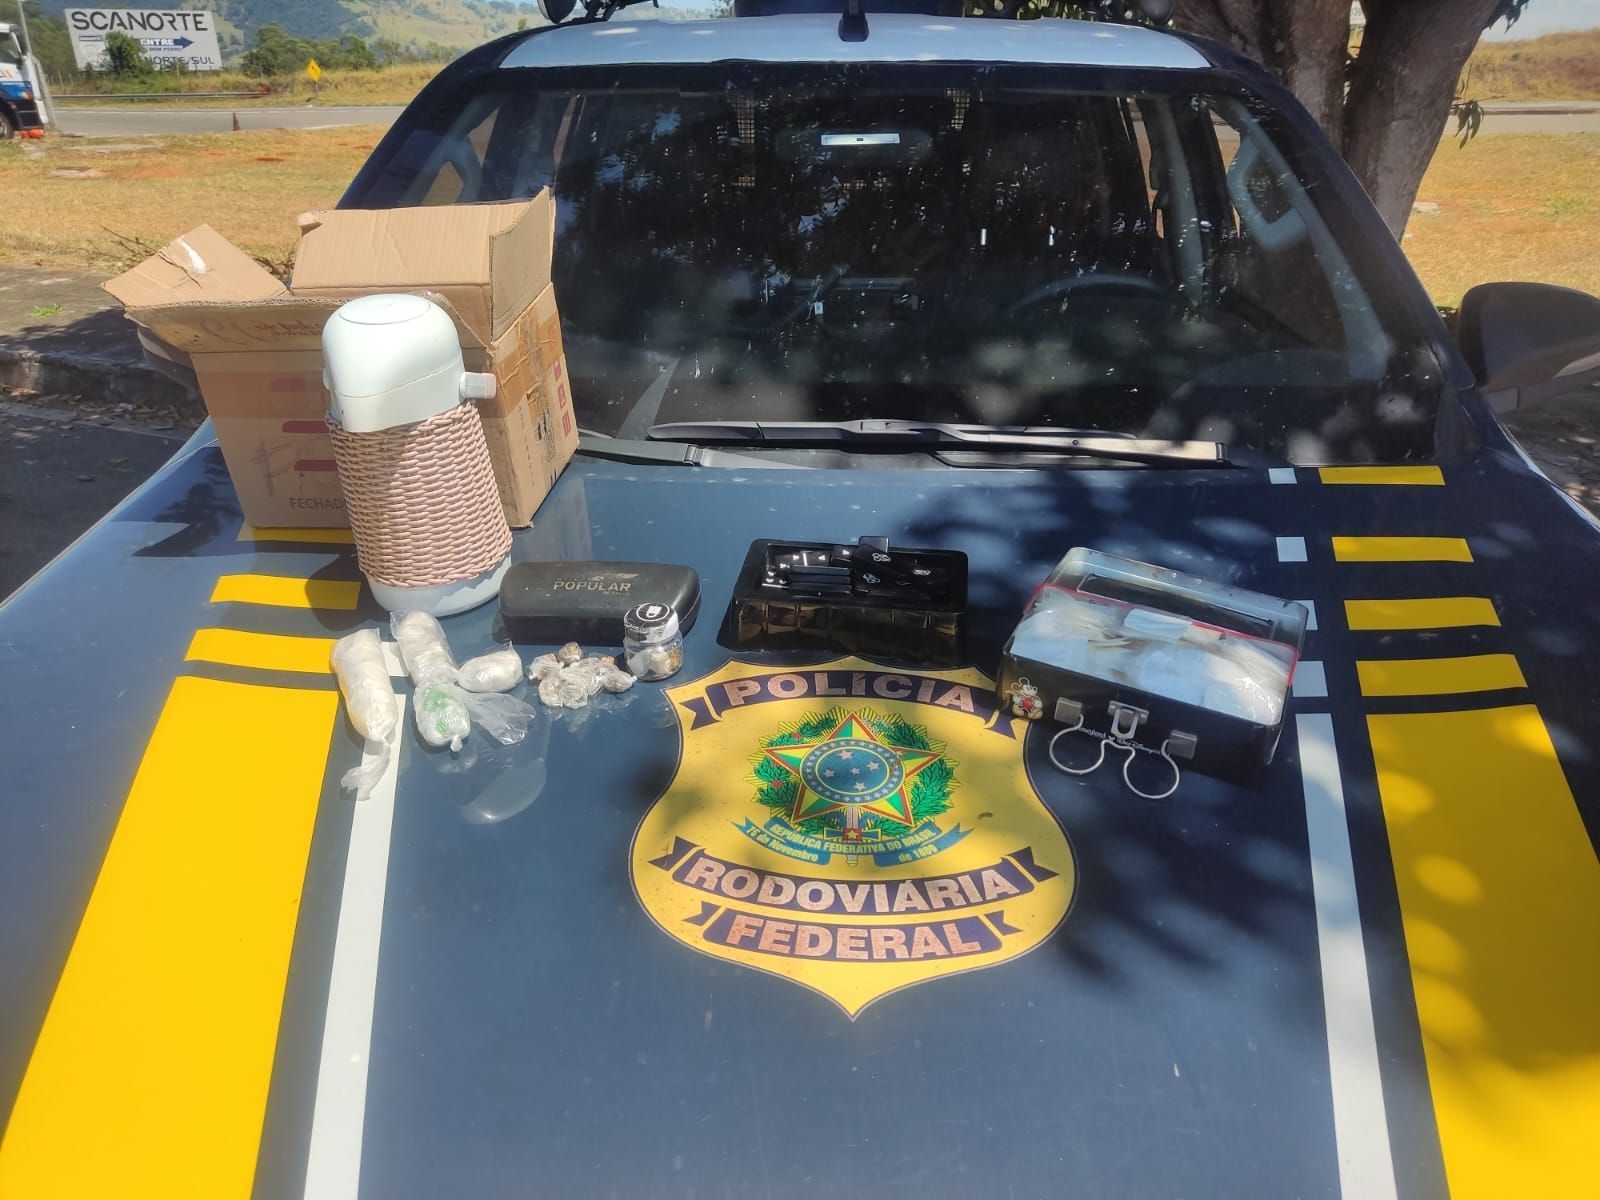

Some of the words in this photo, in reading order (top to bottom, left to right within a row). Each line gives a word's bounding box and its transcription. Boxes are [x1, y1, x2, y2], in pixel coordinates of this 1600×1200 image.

[71, 11, 208, 31] SCANORTE
[140, 38, 174, 46] ENTRE
[289, 497, 346, 511] FECHAD
[552, 580, 632, 592] POPULAR
[723, 672, 974, 712] POLÍCIA
[768, 839, 819, 863] Novembro
[823, 840, 885, 854] FEDERATIVA
[684, 857, 1019, 913] RODOVIÁRIA
[725, 915, 981, 960] FEDERAL
